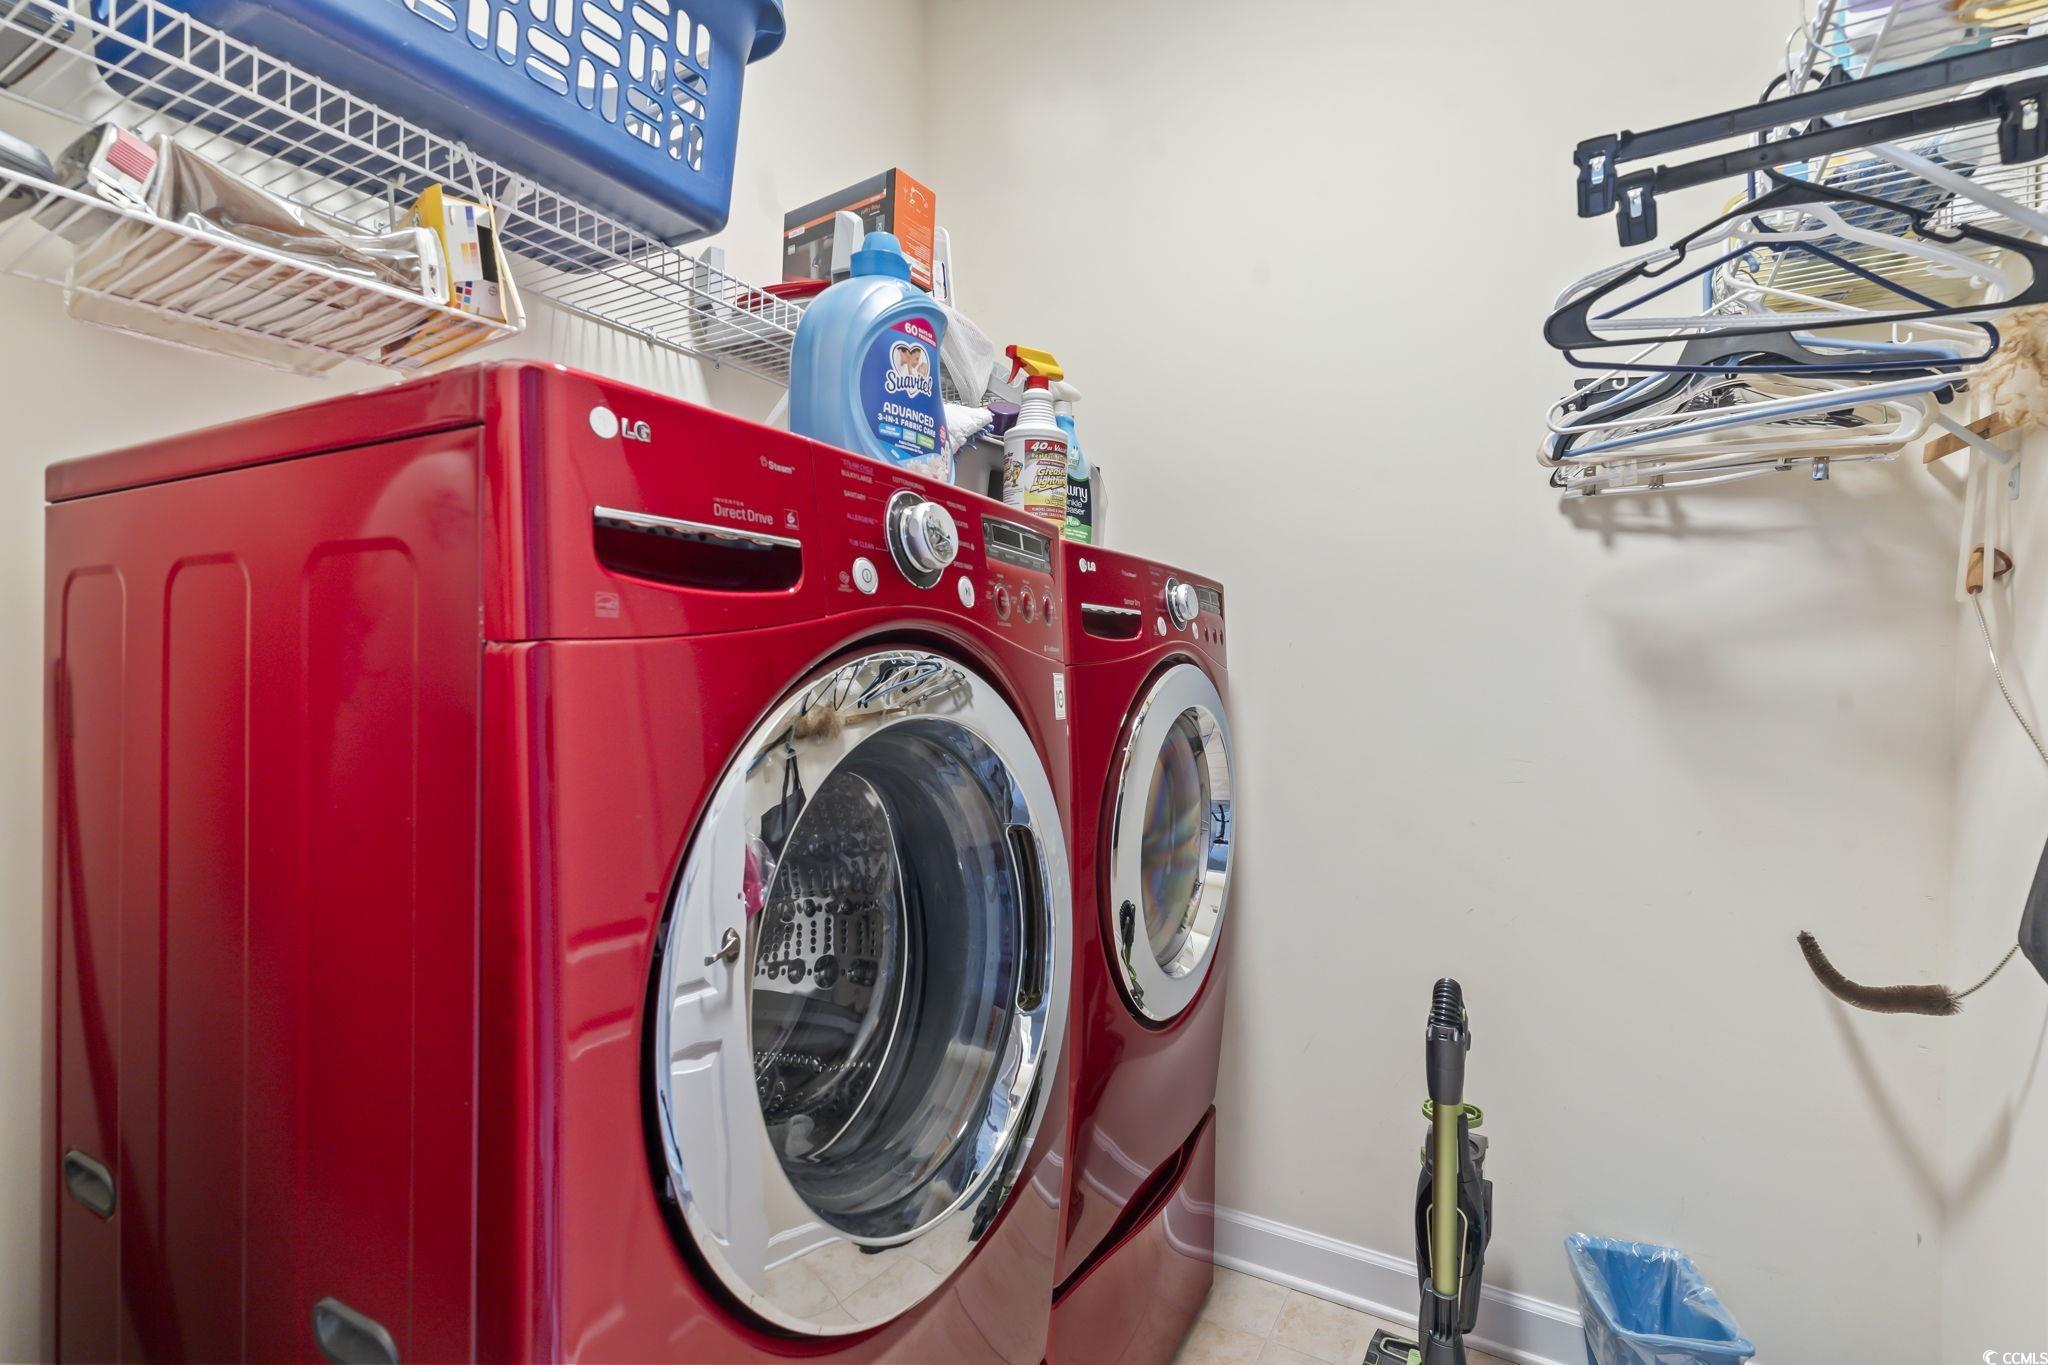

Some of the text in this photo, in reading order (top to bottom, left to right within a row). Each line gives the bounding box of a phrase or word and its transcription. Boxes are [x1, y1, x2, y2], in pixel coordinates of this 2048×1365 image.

[904, 322, 918, 336] 60
[885, 370, 932, 397] Suavitel
[883, 401, 934, 428] ADVANCED
[621, 417, 651, 443] LG
[877, 412, 899, 425] 3-IN-1
[900, 418, 923, 432] FABRIC
[923, 426, 936, 438] CARE
[1031, 441, 1048, 452] 40
[1037, 466, 1066, 476] Grease
[1066, 485, 1088, 503] wny
[713, 503, 774, 526] Direct Drive
[1066, 507, 1086, 516] easer
[1087, 561, 1097, 572] LG
